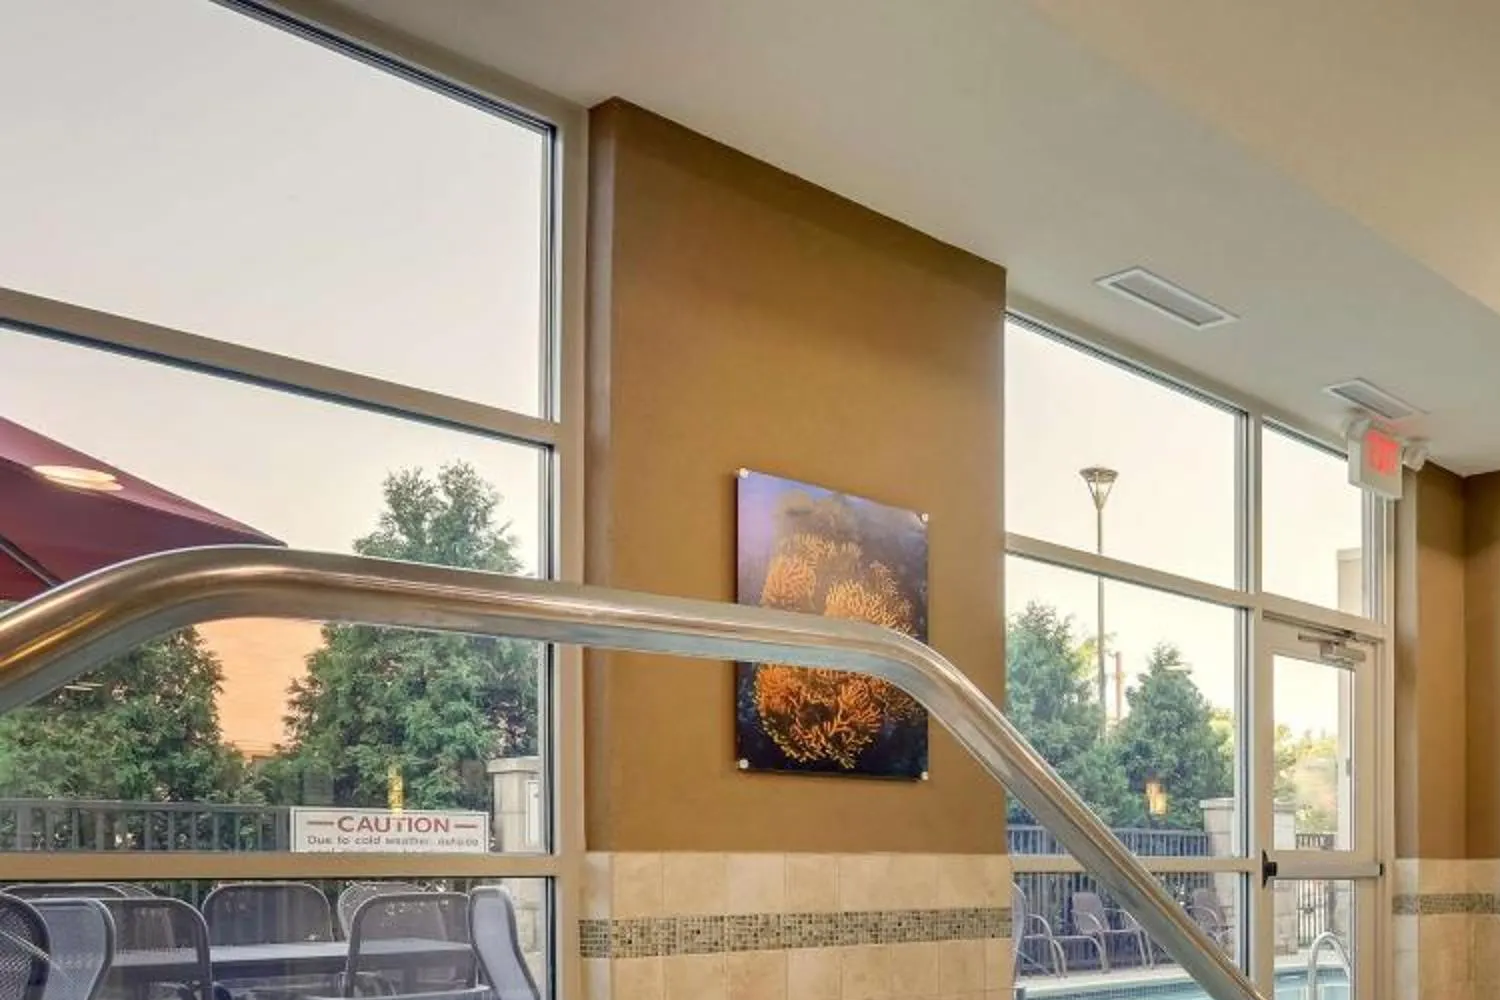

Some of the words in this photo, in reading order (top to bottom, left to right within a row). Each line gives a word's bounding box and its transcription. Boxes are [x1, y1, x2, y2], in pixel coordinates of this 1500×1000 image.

[337, 816, 450, 833] CAUTION
[307, 835, 332, 845] Due
[338, 835, 350, 845] to
[355, 835, 381, 845] cold
